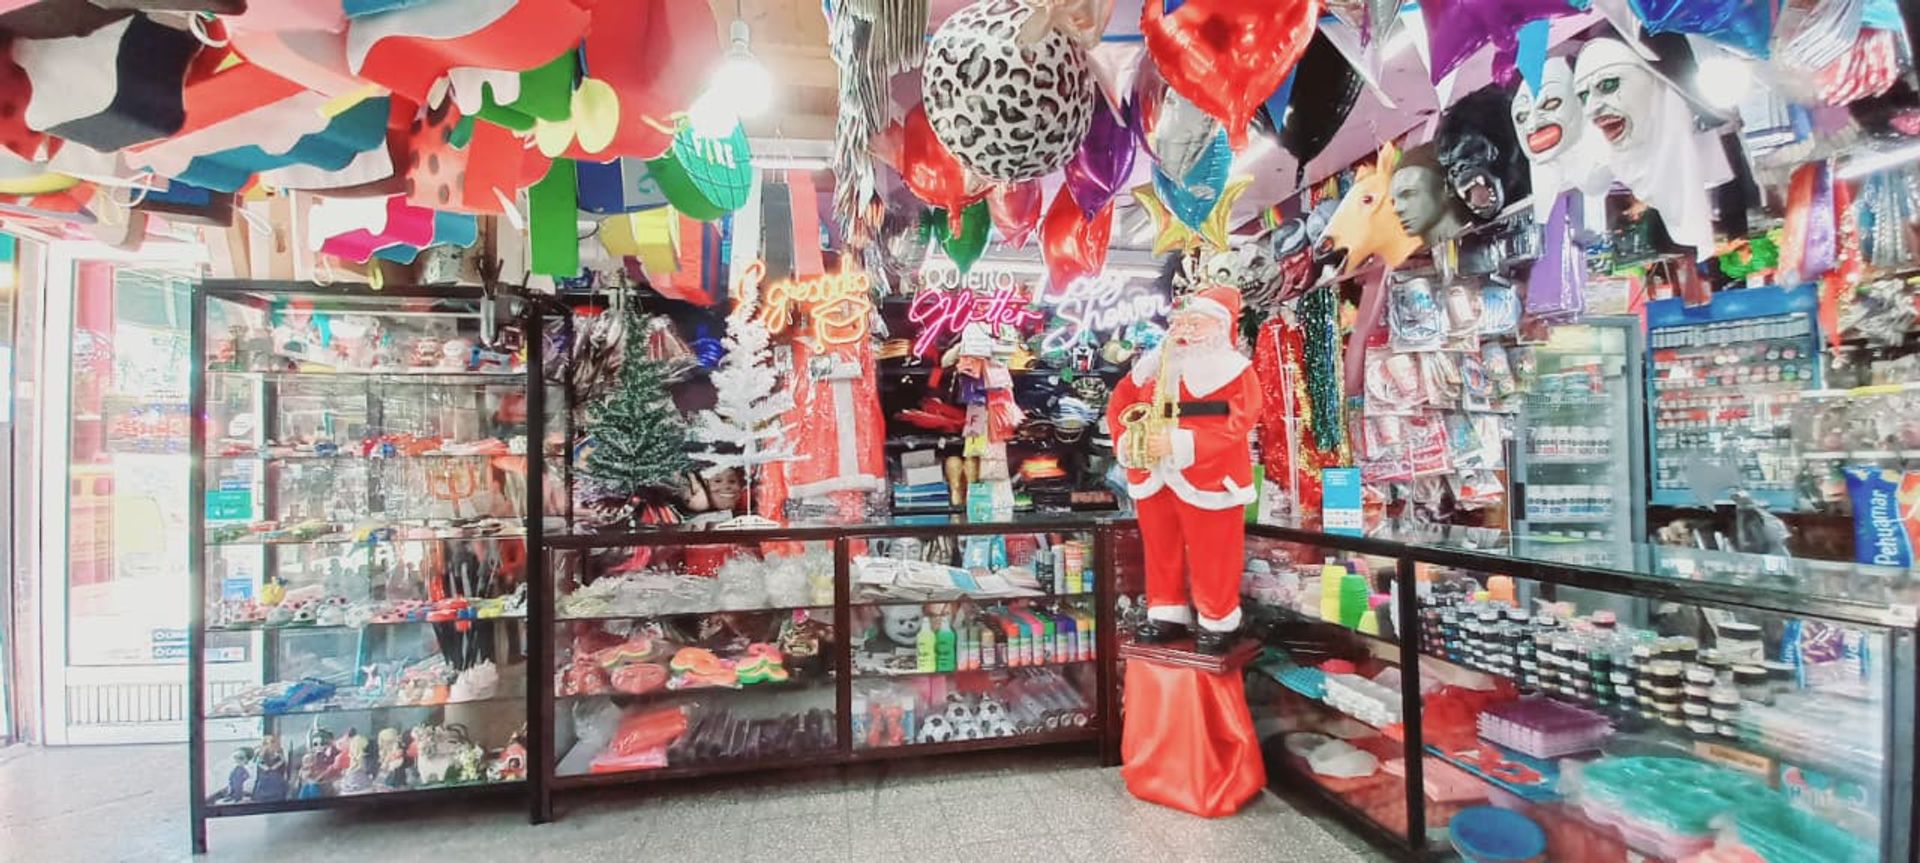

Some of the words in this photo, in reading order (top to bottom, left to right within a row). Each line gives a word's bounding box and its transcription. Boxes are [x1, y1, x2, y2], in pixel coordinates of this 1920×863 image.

[908, 287, 1045, 357] Glitter
[1041, 293, 1172, 352] Shower
[1870, 488, 1900, 566] Pehuamar
